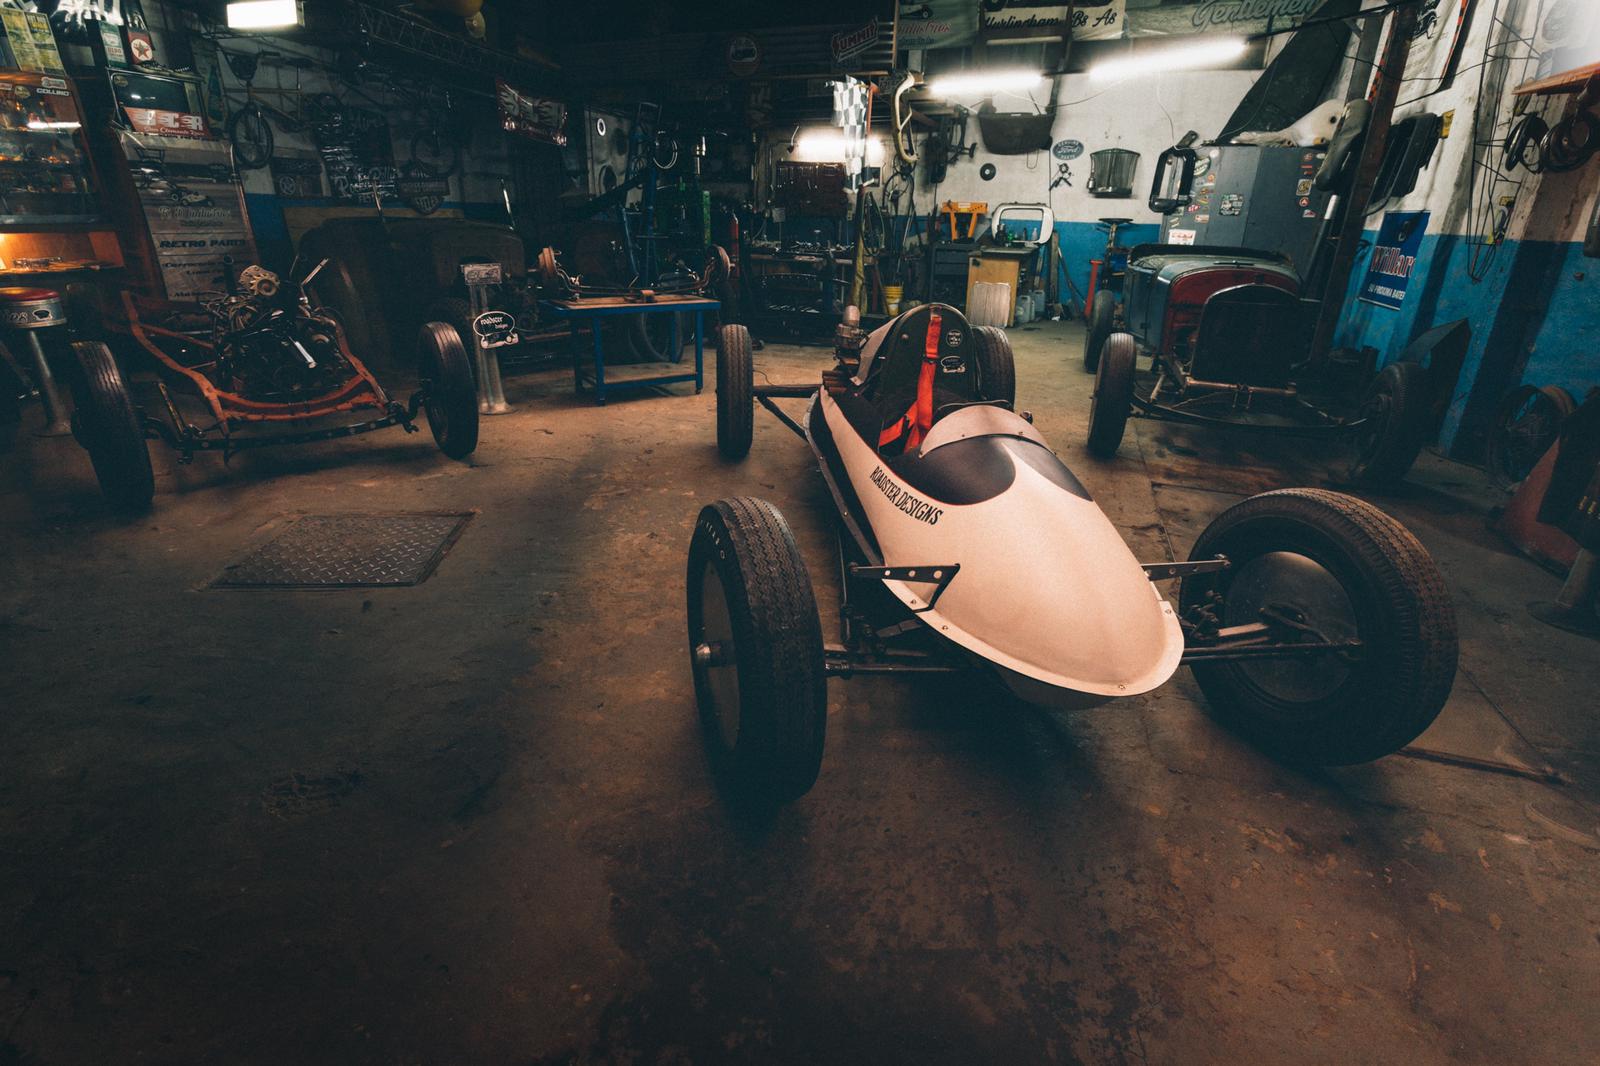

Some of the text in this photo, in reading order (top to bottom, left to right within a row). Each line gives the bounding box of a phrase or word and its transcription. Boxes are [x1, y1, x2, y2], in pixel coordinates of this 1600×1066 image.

[1092, 8, 1117, 27] As
[159, 240, 207, 248] RETRO
[1369, 245, 1417, 278] Willar
[869, 465, 944, 526] ROADSTER DESIGNS
